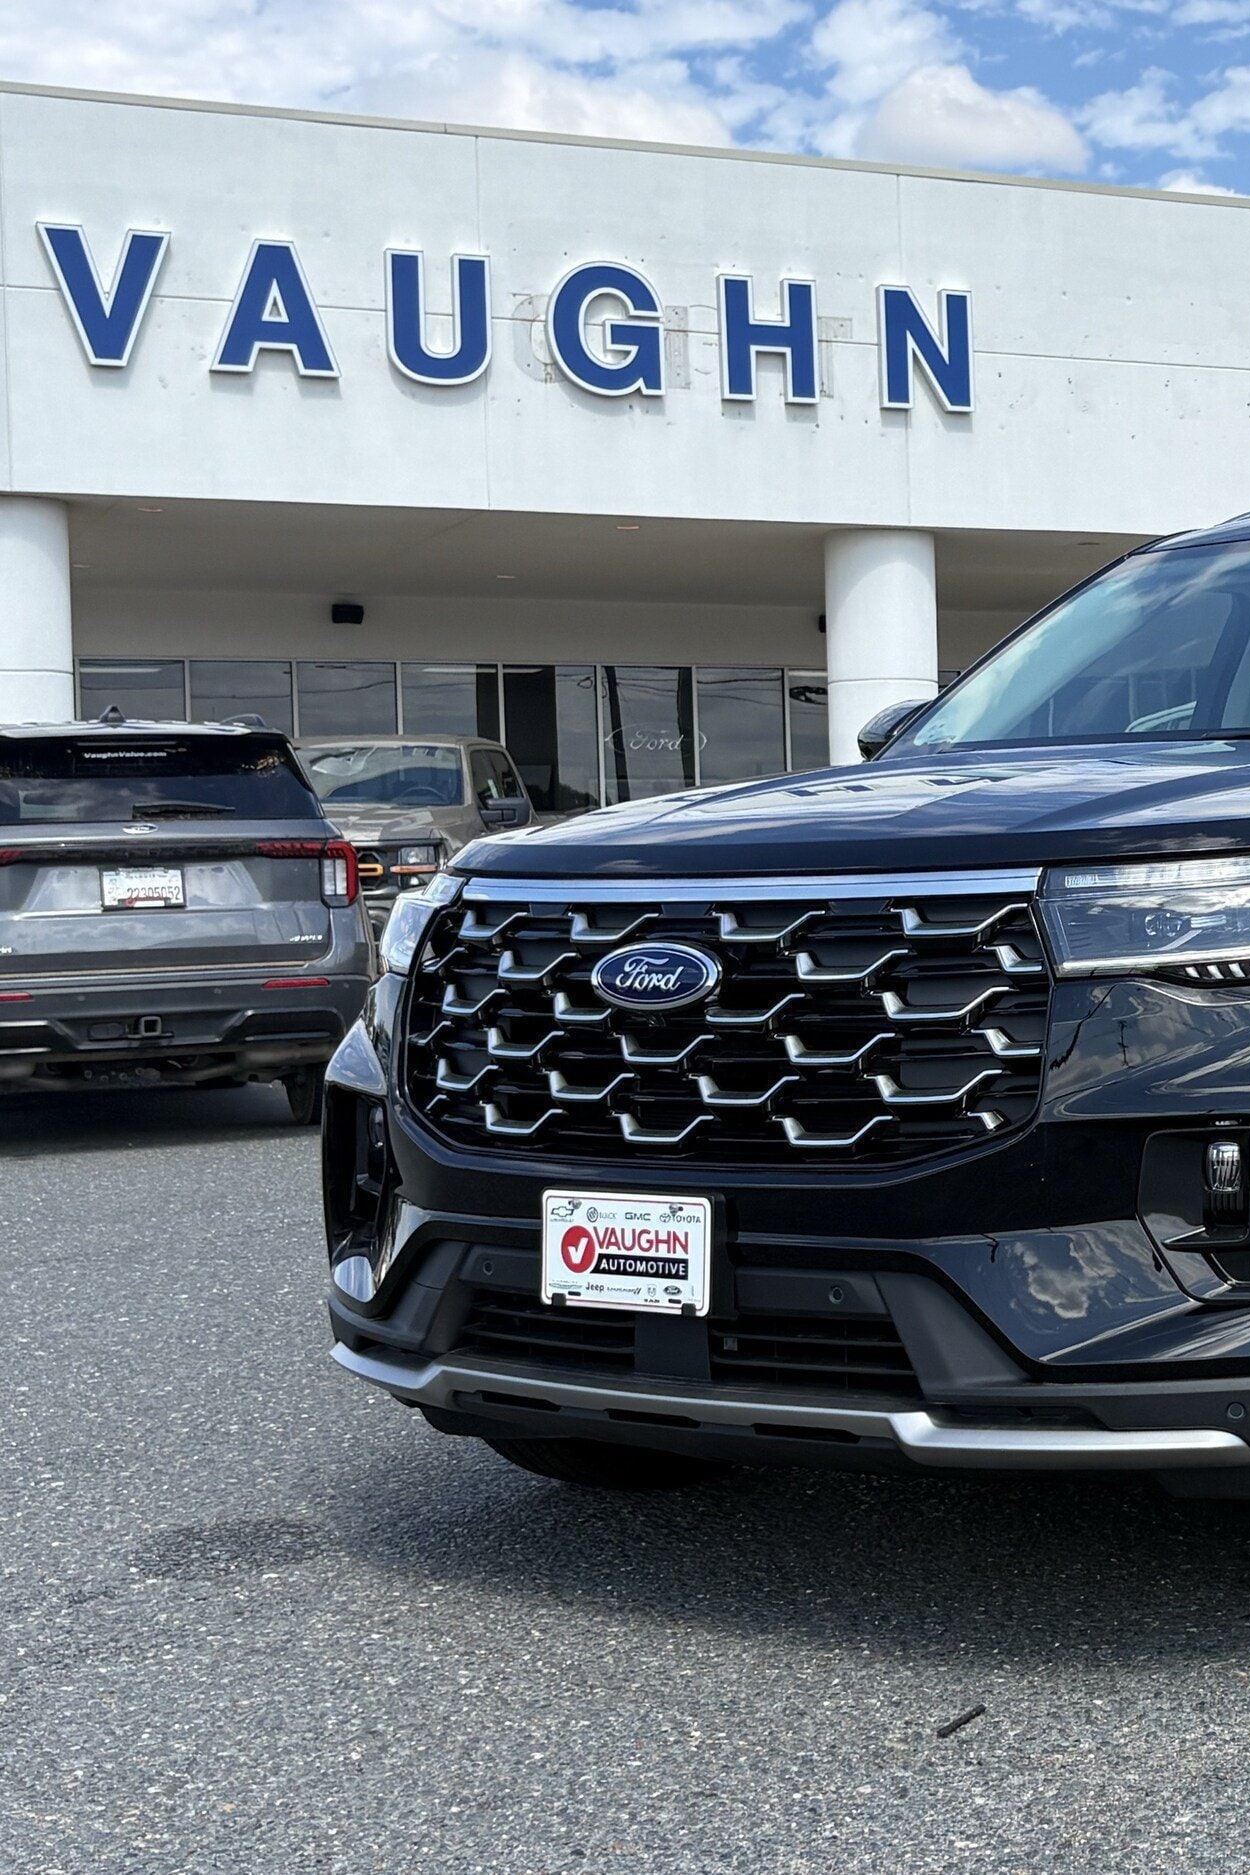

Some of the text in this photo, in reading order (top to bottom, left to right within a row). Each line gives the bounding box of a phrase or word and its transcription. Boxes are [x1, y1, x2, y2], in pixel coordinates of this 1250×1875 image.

[36, 221, 975, 413] VAUGHN
[630, 729, 684, 750] Ford
[615, 955, 685, 993] Ford
[624, 1212, 651, 1221] GMC
[672, 1214, 702, 1223] TOYOTA
[593, 1226, 688, 1255] VAUGHN
[600, 1258, 686, 1275] AUTOMOTIVE
[585, 1282, 604, 1292] Jeep
